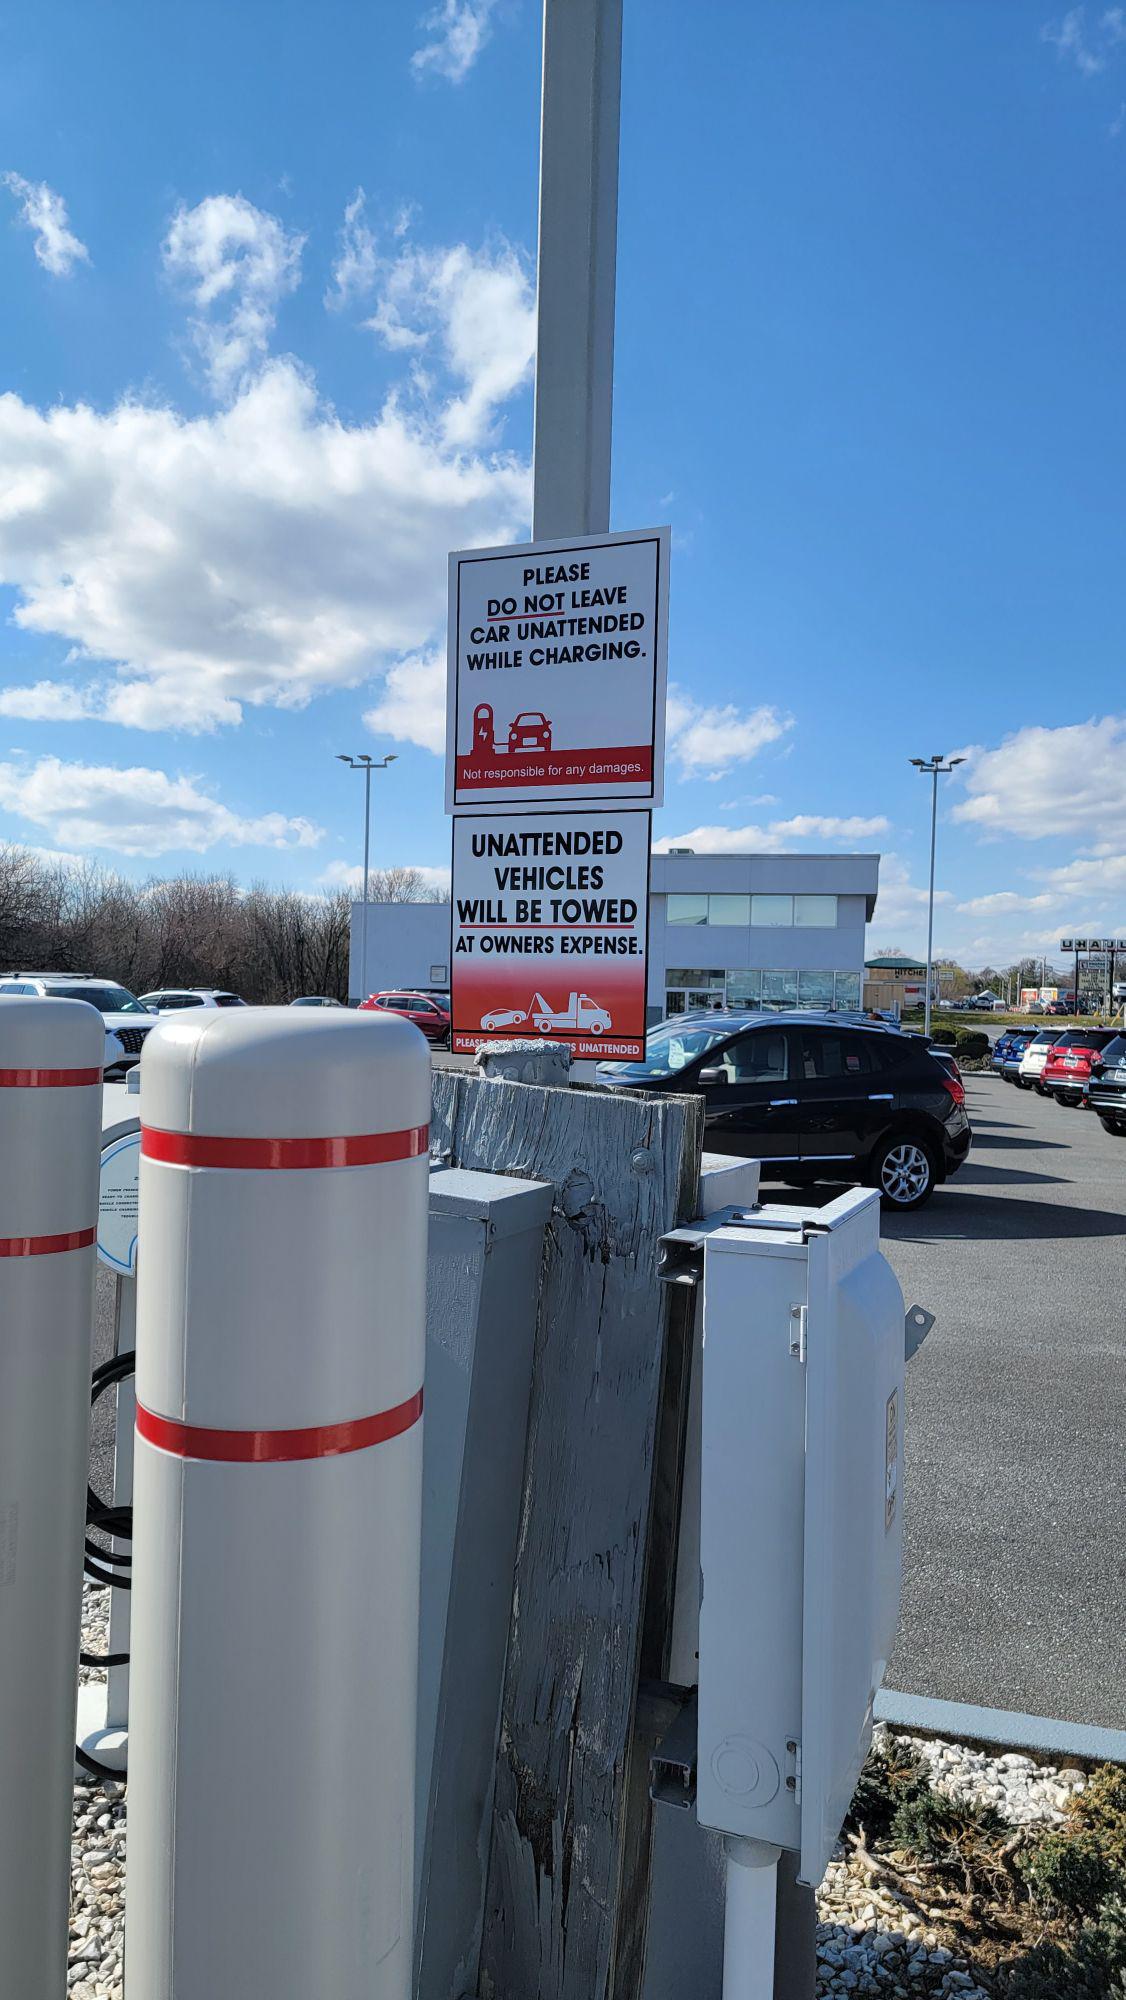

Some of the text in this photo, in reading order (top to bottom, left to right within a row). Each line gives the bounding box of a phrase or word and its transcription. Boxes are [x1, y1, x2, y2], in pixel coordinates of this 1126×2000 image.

[523, 562, 590, 586] PLEASE
[487, 585, 627, 617] DO NOT LEAVE
[470, 612, 645, 645] CAR UNATTENDED
[467, 640, 646, 671] WHILE CHARGING.
[463, 762, 644, 781] Not responsible for any damages.
[472, 830, 623, 857] UNATTENDED
[494, 866, 604, 890] VEHICLES
[456, 899, 638, 923] WILL BE TOWED
[455, 935, 643, 955] AT OWNERS EXPENSE.
[579, 1042, 640, 1054] UNATTENDED
